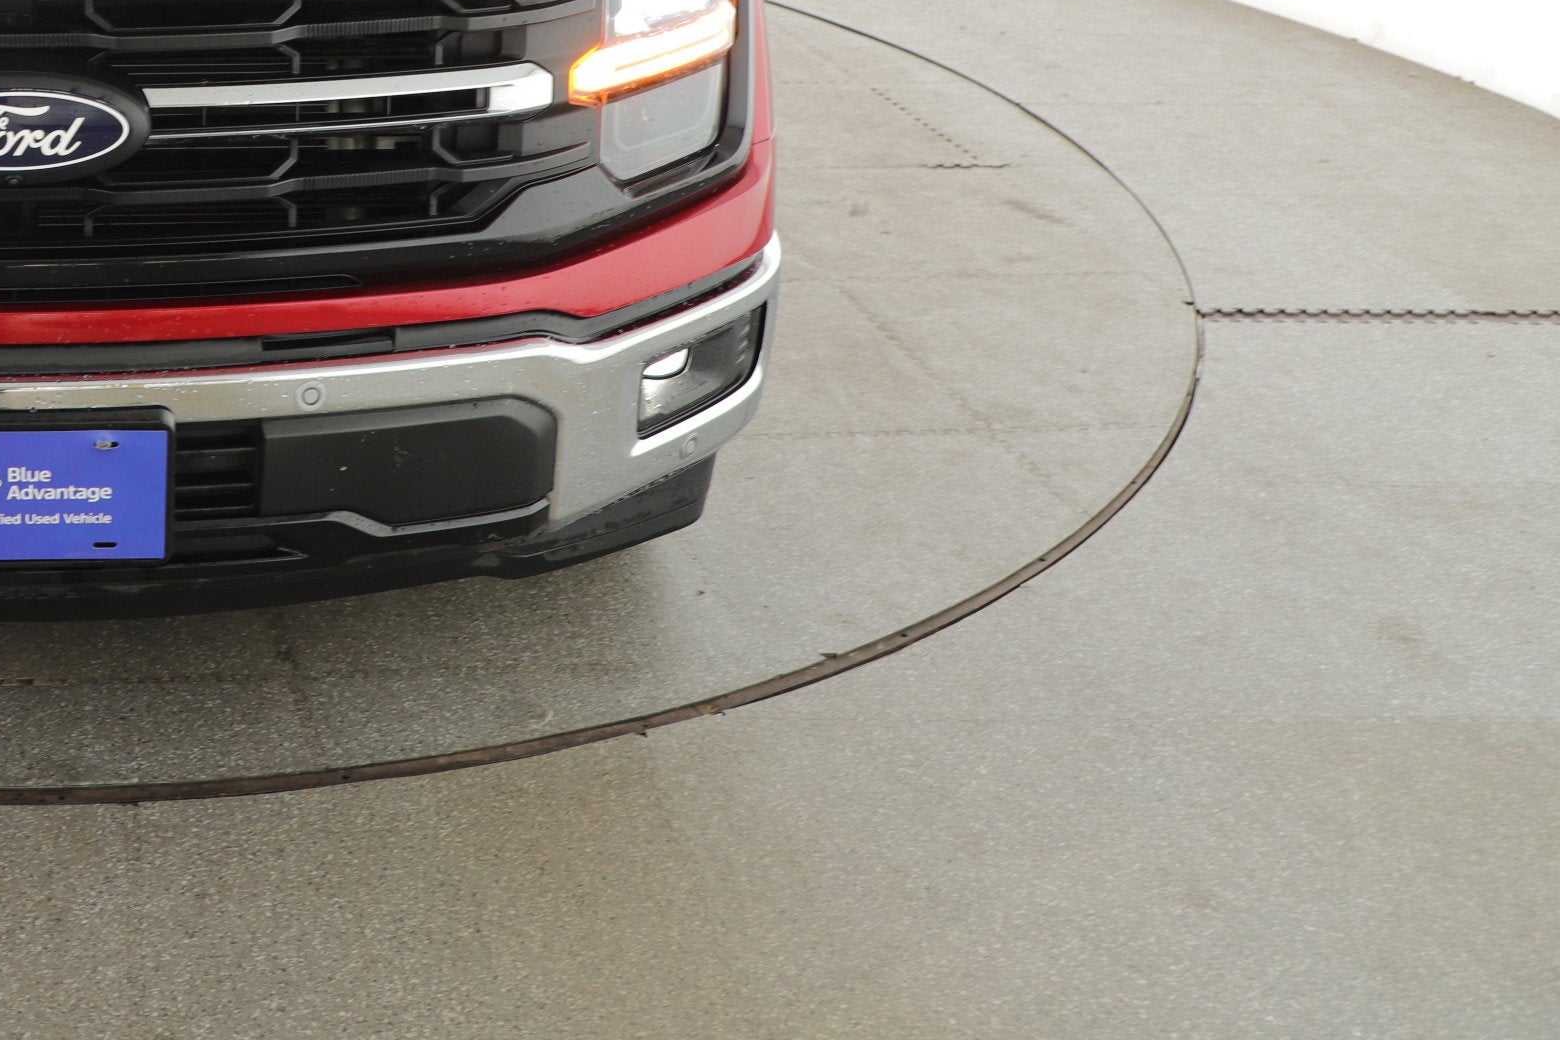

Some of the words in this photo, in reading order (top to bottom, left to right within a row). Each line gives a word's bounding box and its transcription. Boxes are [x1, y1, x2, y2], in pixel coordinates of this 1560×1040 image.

[7, 467, 52, 482] Blue
[6, 485, 113, 502] Advantage
[24, 513, 60, 524] Used
[63, 512, 113, 524] Vehicle
